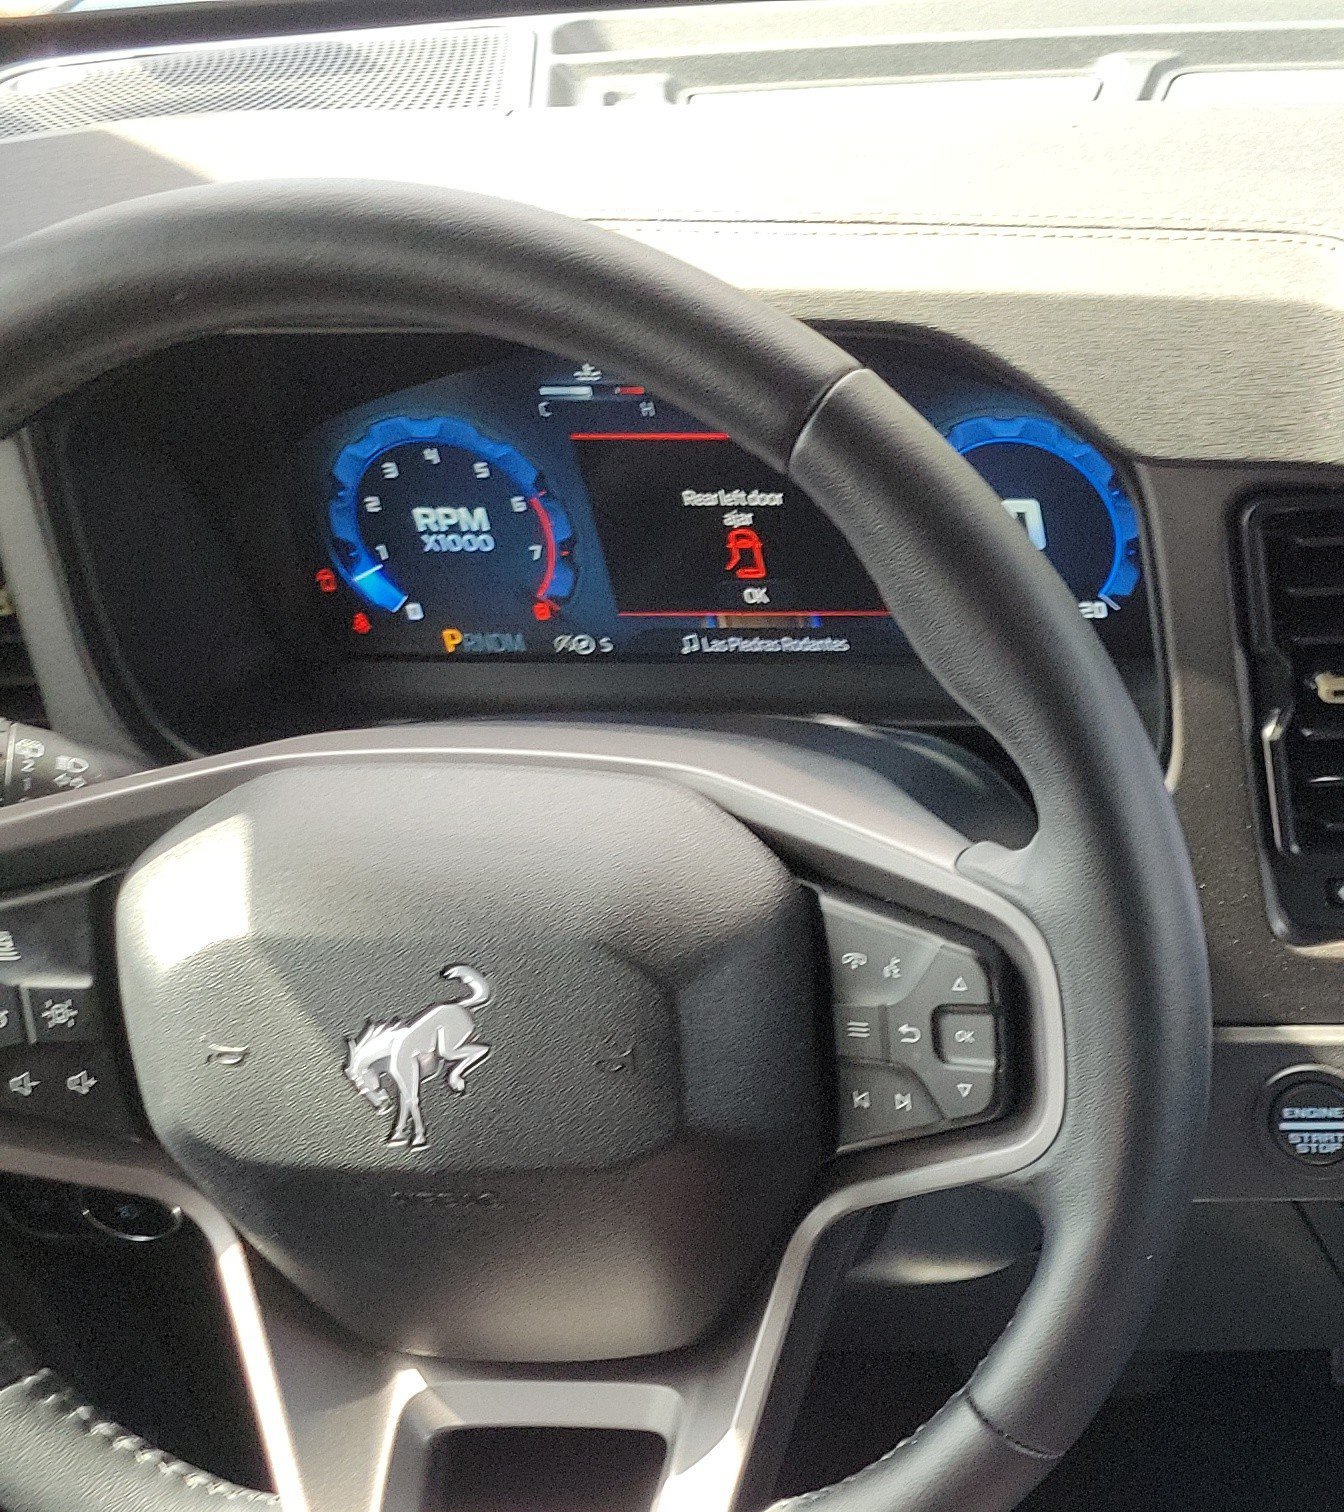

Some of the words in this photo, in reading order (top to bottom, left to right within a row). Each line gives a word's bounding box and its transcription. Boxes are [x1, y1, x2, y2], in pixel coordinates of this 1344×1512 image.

[381, 461, 399, 479] 3
[473, 461, 491, 479] 5
[364, 496, 382, 513] 2
[681, 489, 718, 507] Rear
[719, 488, 746, 507] left
[747, 489, 784, 507] door
[412, 506, 492, 532] RPM
[420, 533, 496, 553] X1000
[375, 544, 390, 561] 1
[528, 544, 543, 561] 7
[743, 587, 770, 605] OK
[701, 636, 727, 653] Las
[728, 636, 780, 653] Piedras
[781, 636, 850, 653] Rodantes
